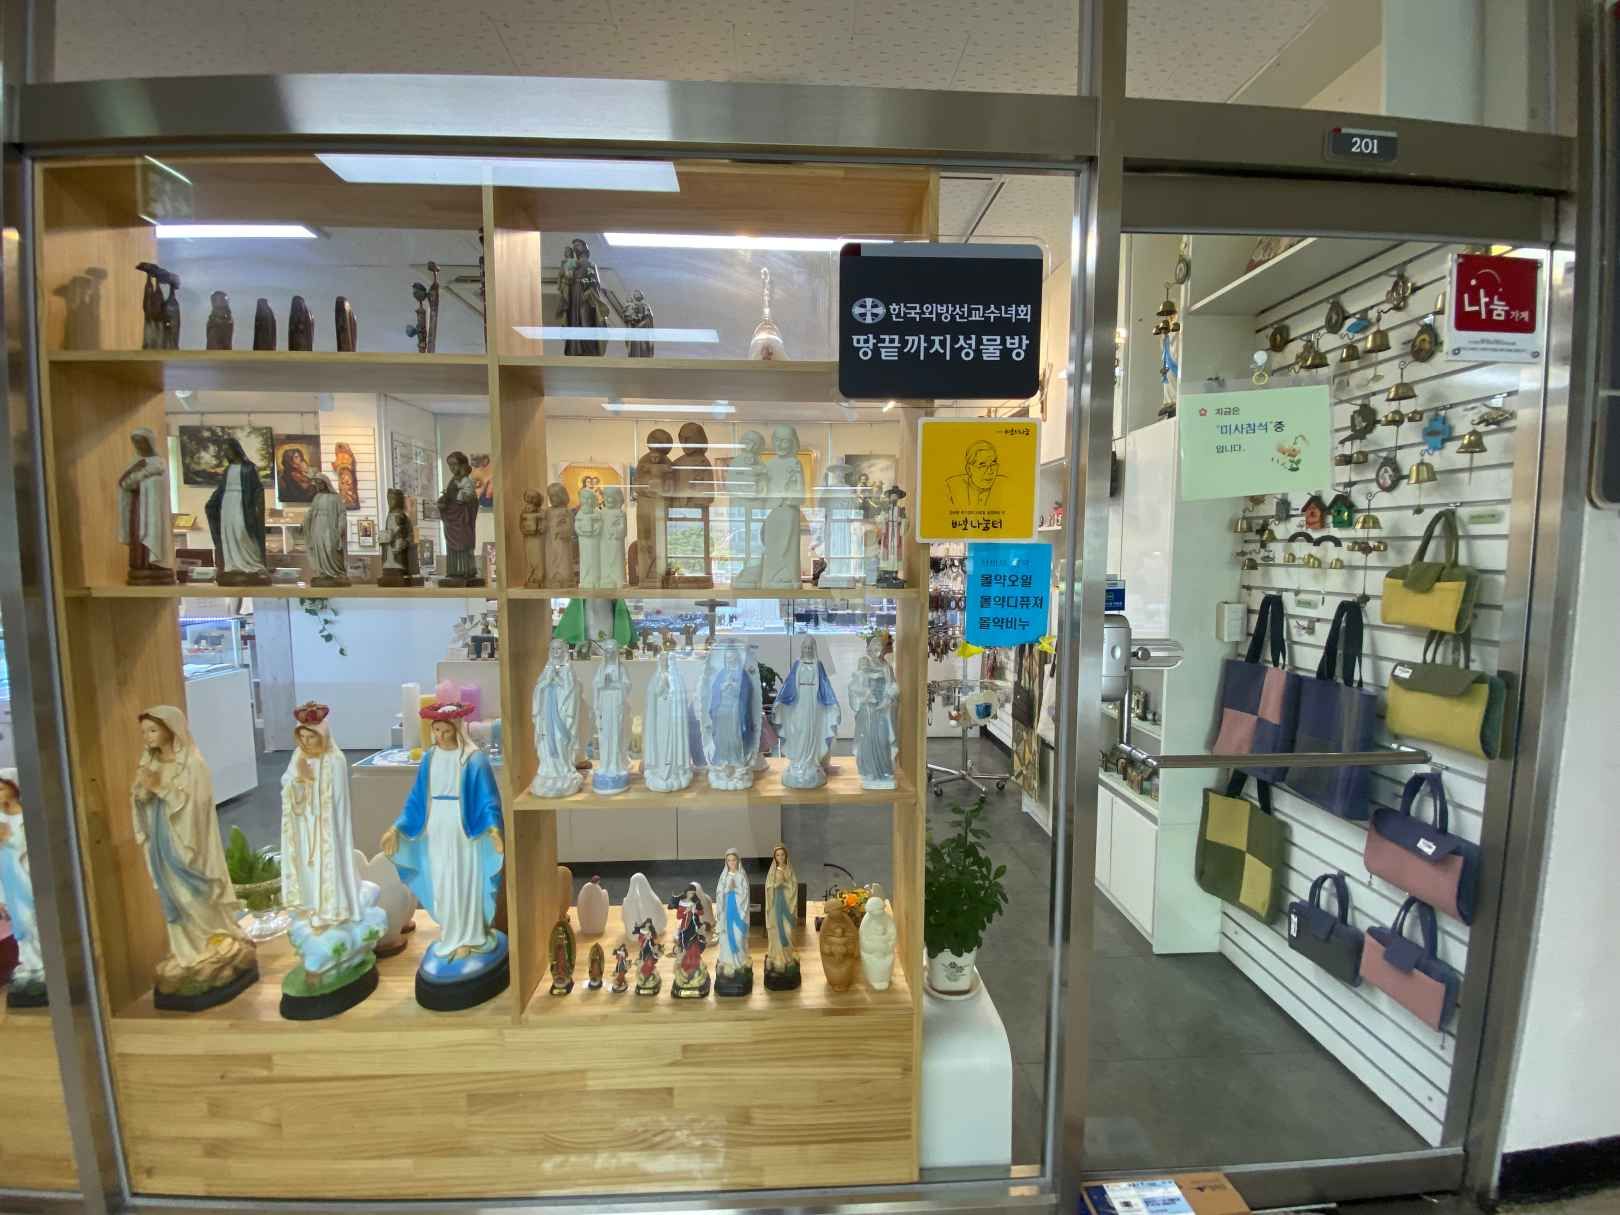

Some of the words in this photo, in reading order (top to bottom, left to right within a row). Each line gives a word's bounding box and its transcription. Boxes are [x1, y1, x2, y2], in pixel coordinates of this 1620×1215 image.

[1351, 136, 1378, 154] 201
[889, 302, 1031, 323] 한국외방선교수녀회
[1463, 288, 1510, 320] 나눔
[851, 334, 1030, 361] 땅끝까지성물방
[1215, 406, 1240, 416] 지금은
[1215, 443, 1246, 454] 입니다.
